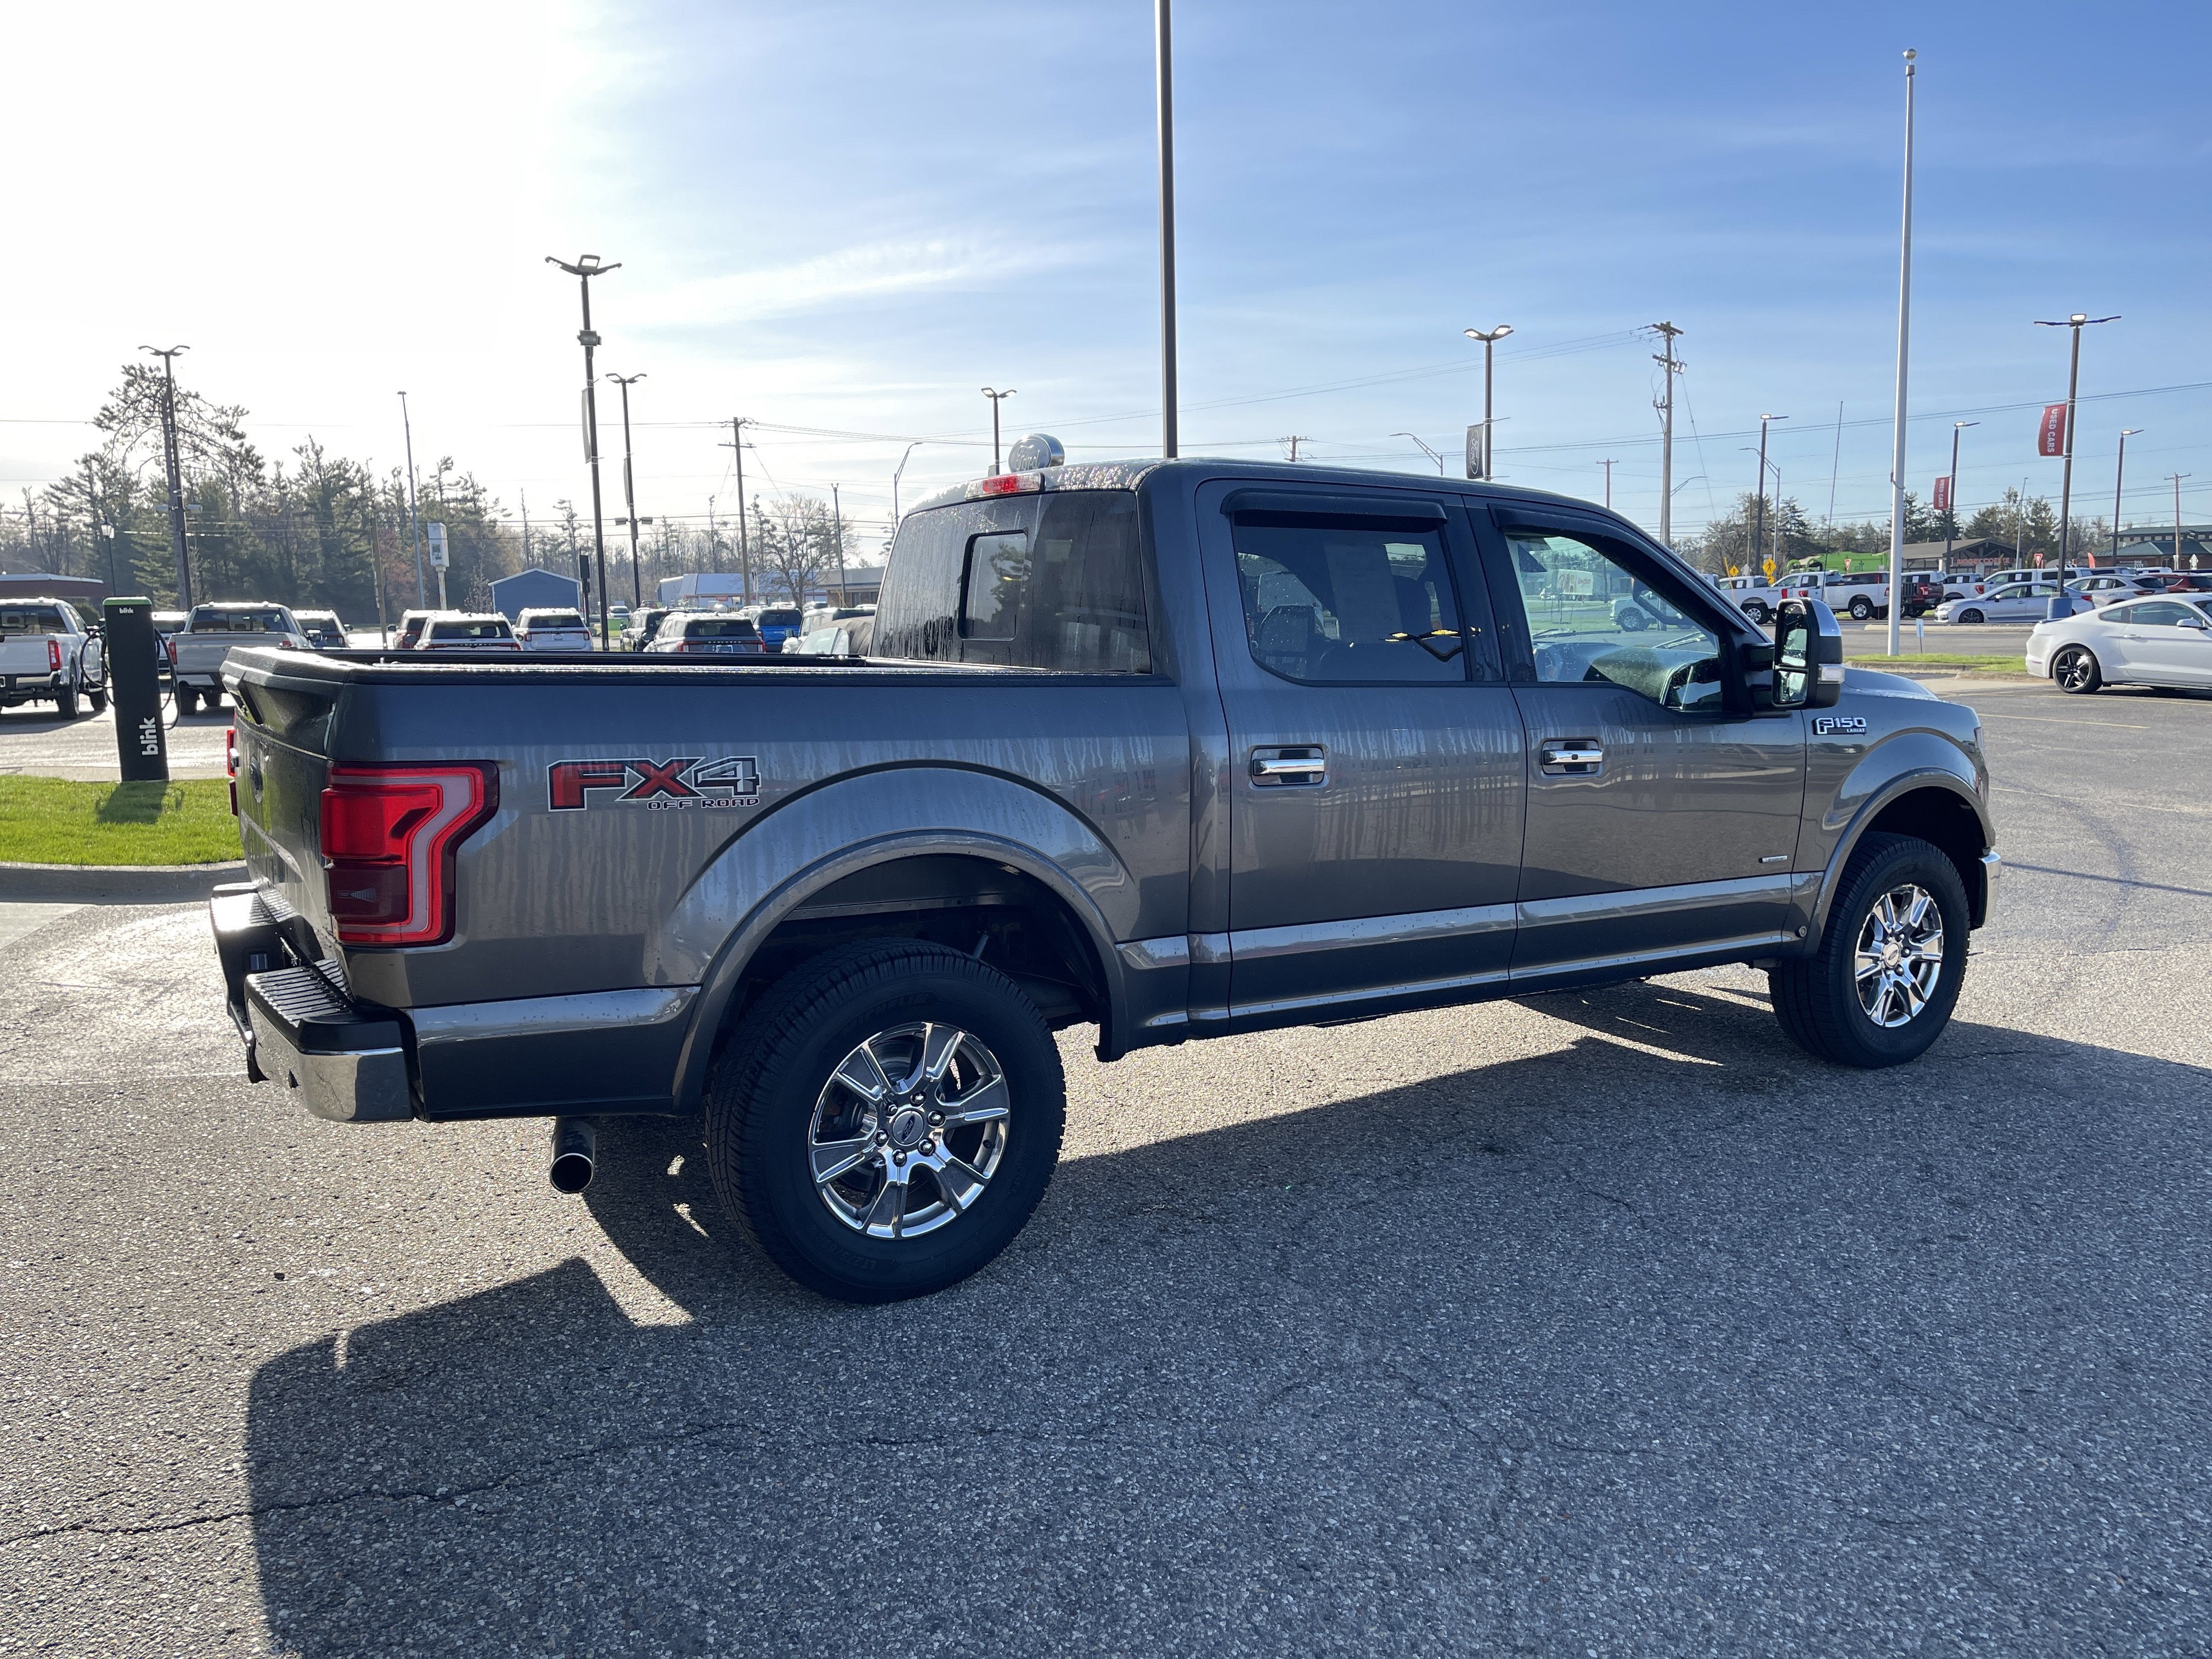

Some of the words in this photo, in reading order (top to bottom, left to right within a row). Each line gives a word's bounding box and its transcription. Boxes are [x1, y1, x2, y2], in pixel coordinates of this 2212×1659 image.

[2049, 408, 2059, 430] USED
[2047, 431, 2056, 453] CARS
[1016, 444, 1041, 472] Ford
[139, 716, 159, 755] blink
[546, 755, 762, 811] FX4
[647, 799, 693, 810] OFF
[701, 797, 760, 808] ROAD
[904, 1119, 914, 1136] Ford
